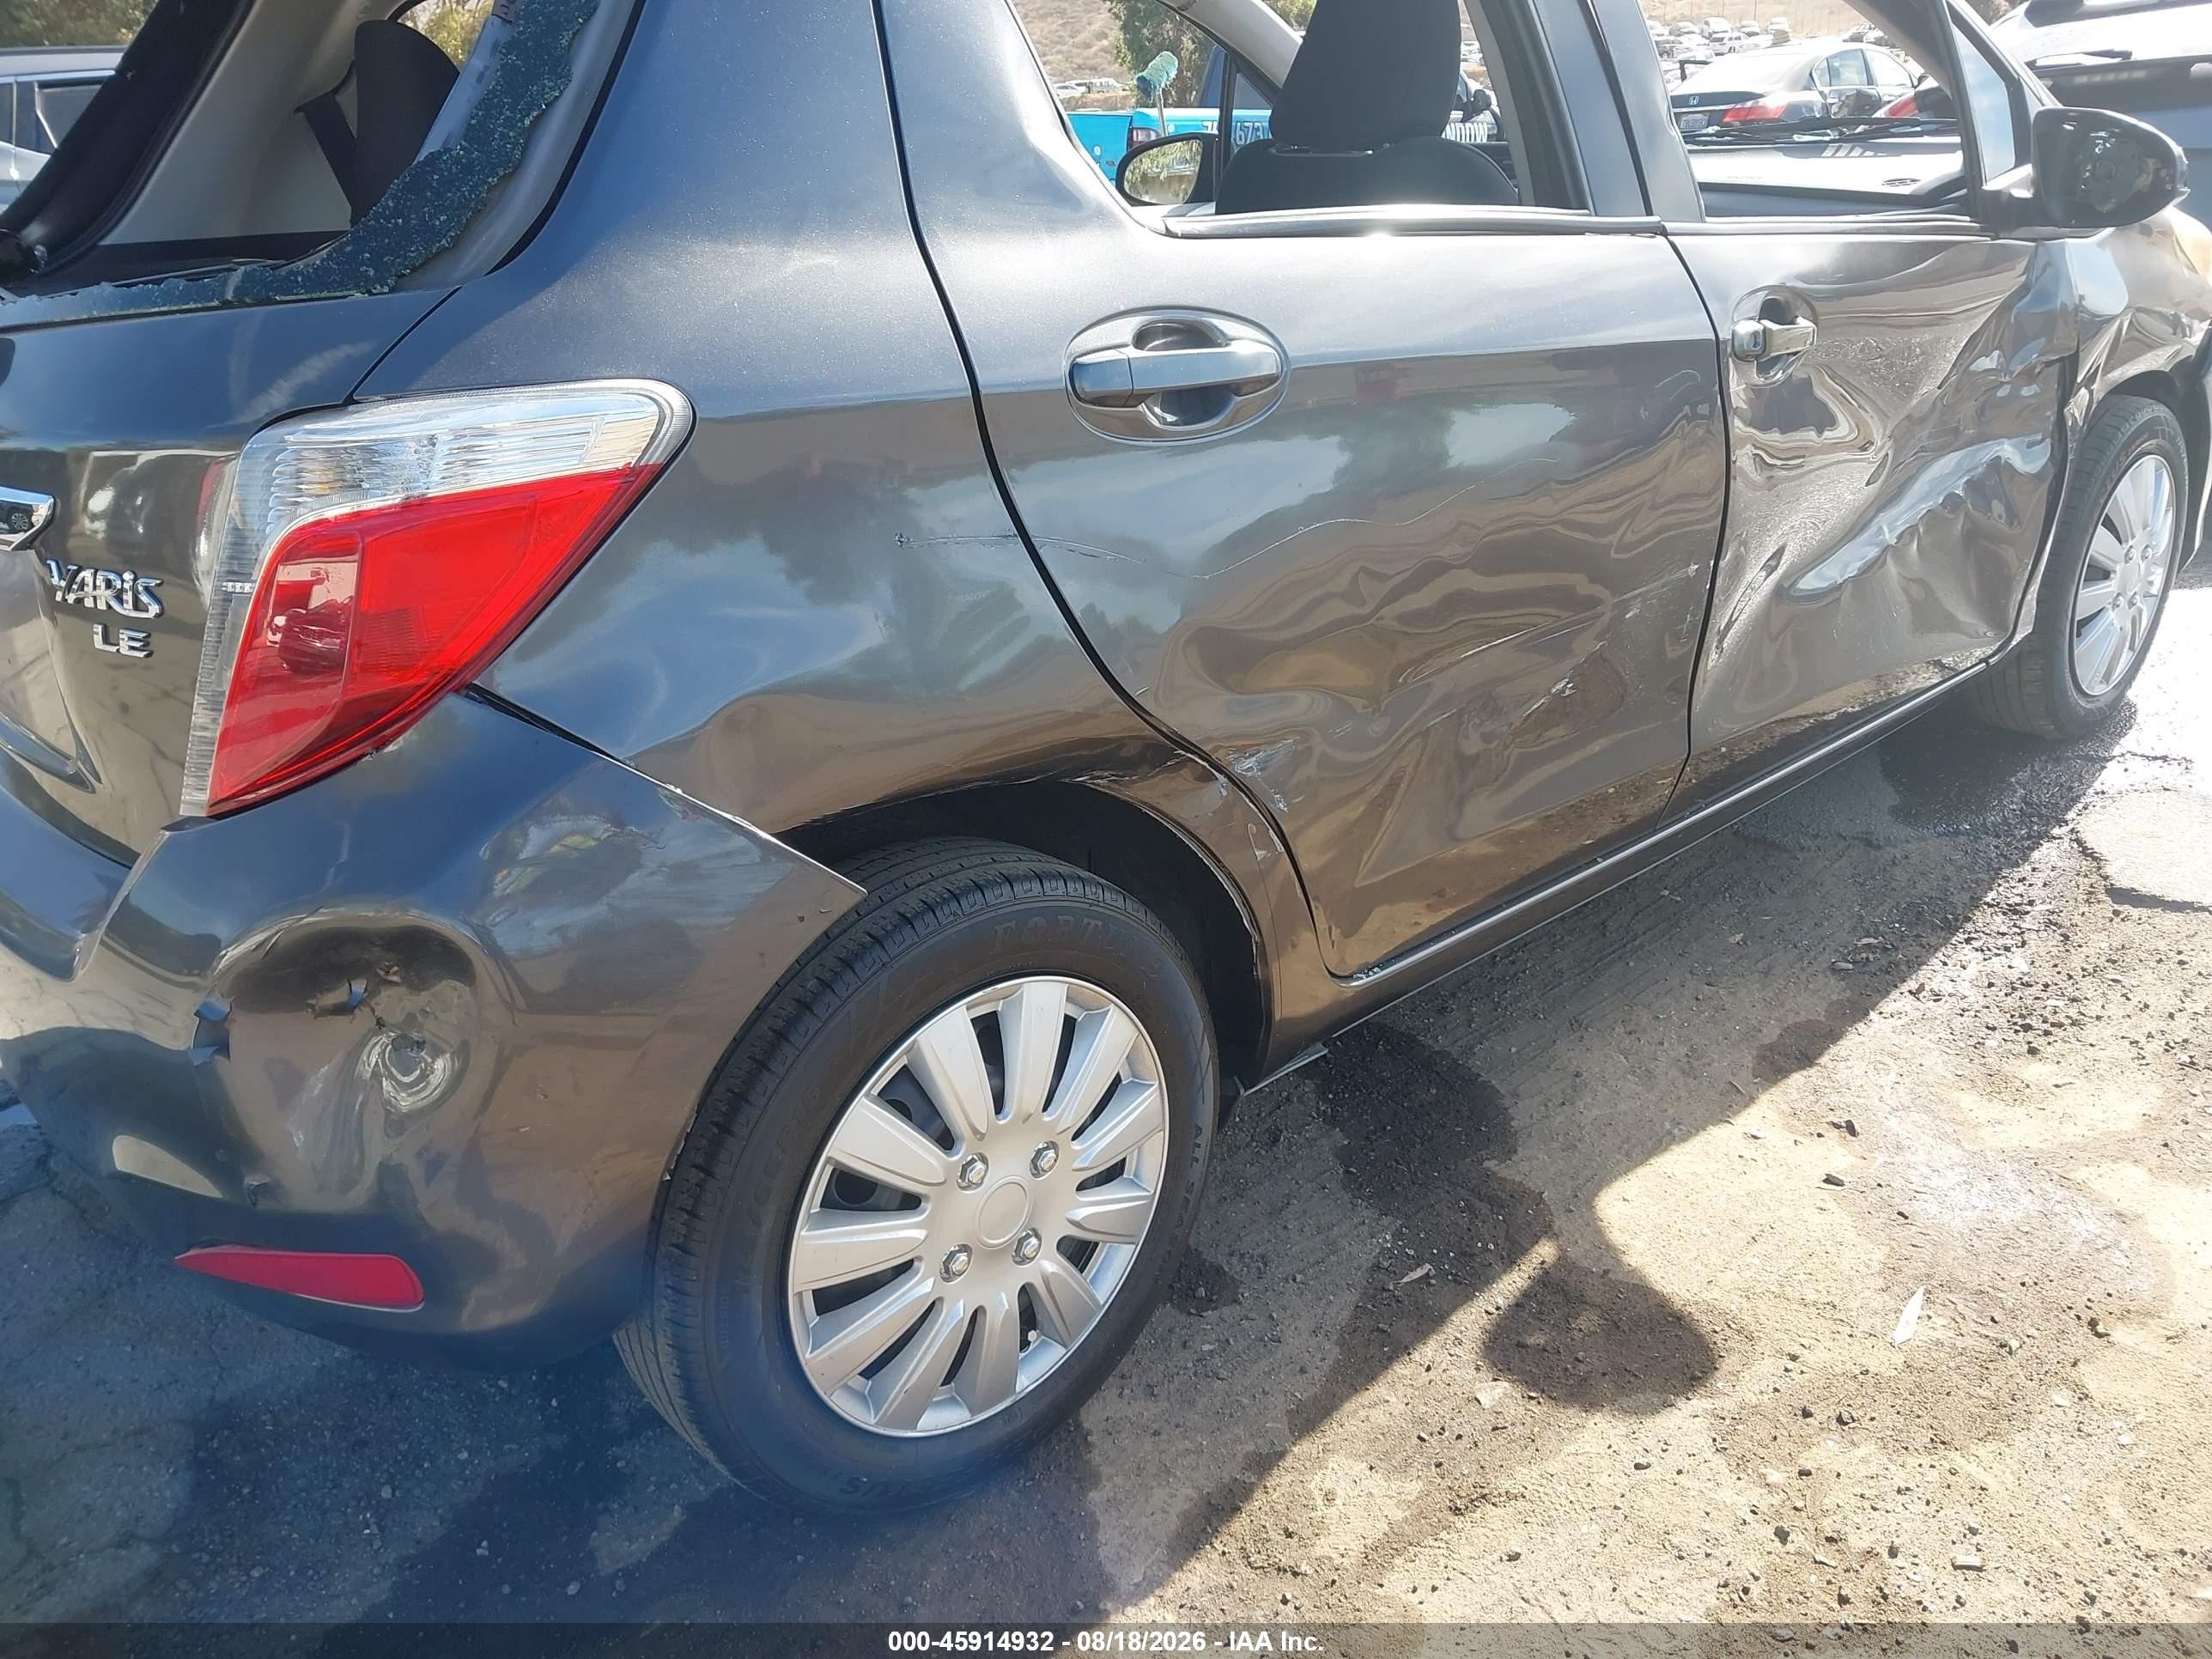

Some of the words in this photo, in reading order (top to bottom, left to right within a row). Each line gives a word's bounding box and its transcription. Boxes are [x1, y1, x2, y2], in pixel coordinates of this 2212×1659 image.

[1236, 121, 1264, 145] 673
[93, 623, 154, 659] LE
[1189, 1122, 1203, 1169] ALL
